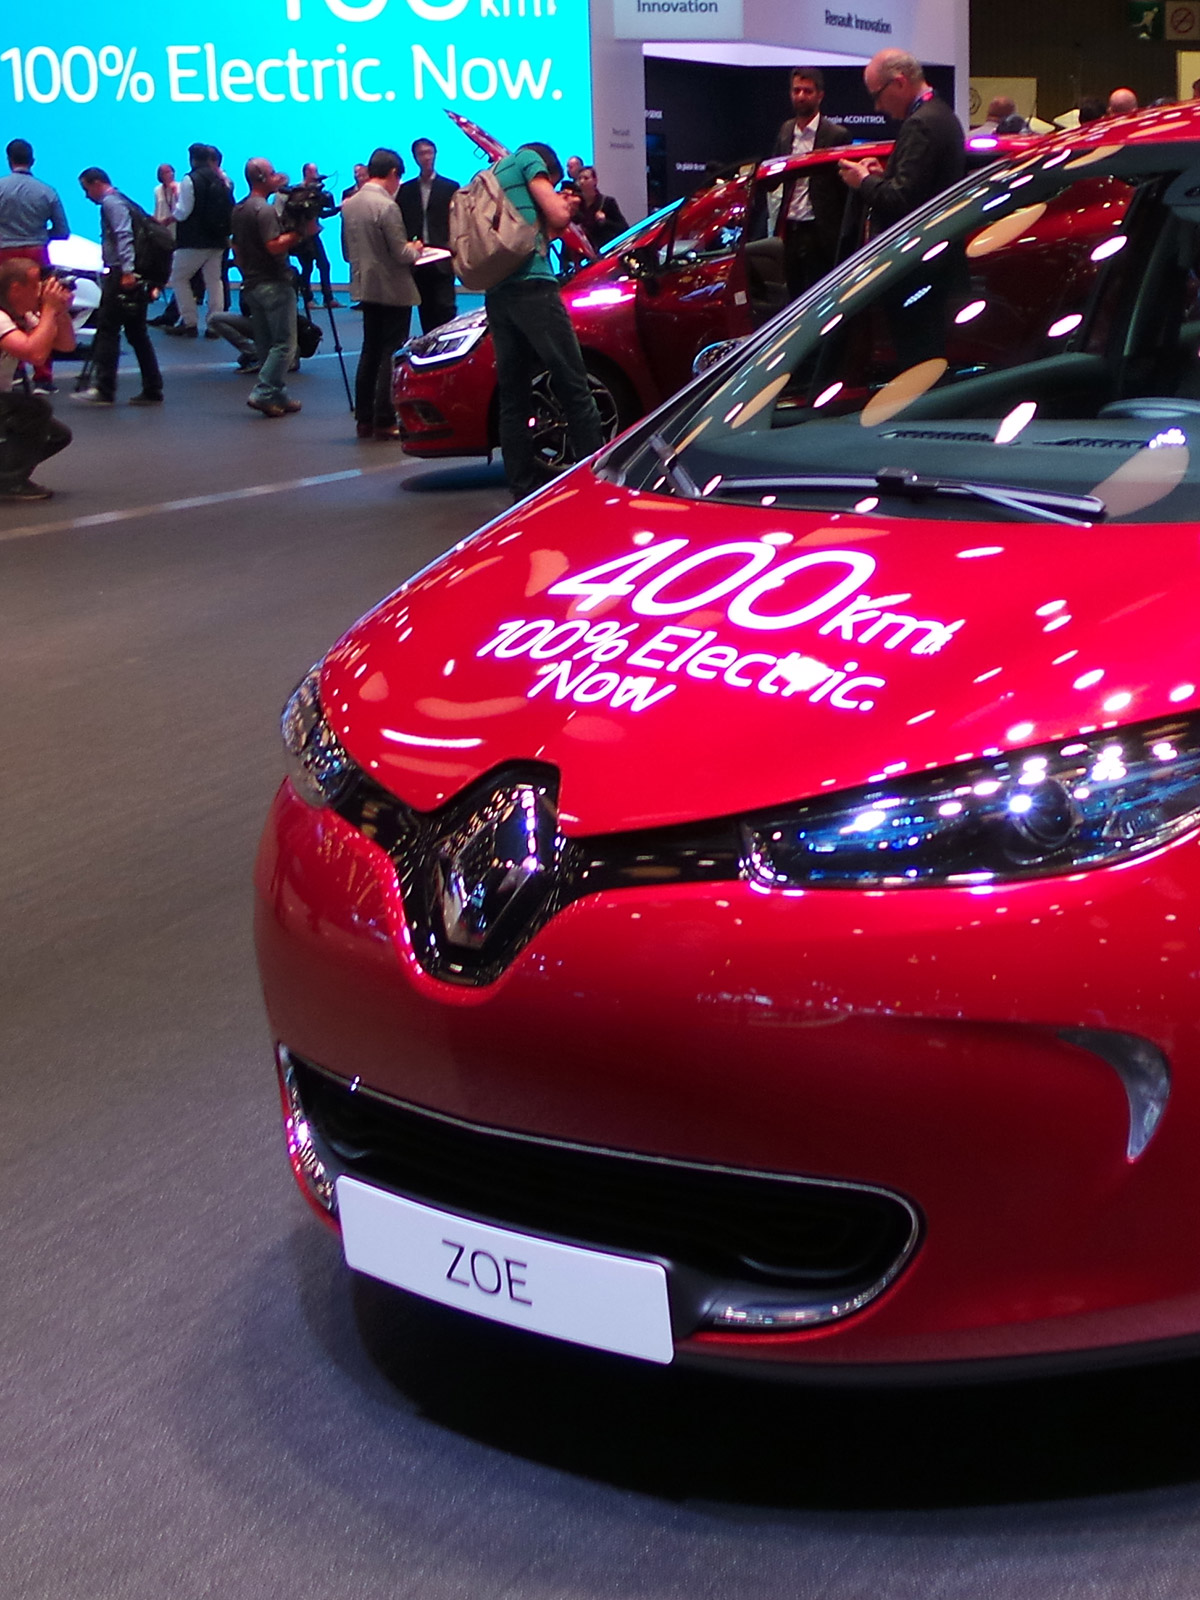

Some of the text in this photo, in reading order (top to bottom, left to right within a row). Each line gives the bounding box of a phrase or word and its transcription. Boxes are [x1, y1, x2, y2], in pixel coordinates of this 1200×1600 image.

[637, 0, 719, 13] Innovation
[0, 43, 563, 103] 100% Electric. Now.
[476, 619, 886, 712] 100% Electric.
[526, 660, 677, 713] Now
[441, 1239, 533, 1307] ZOE
